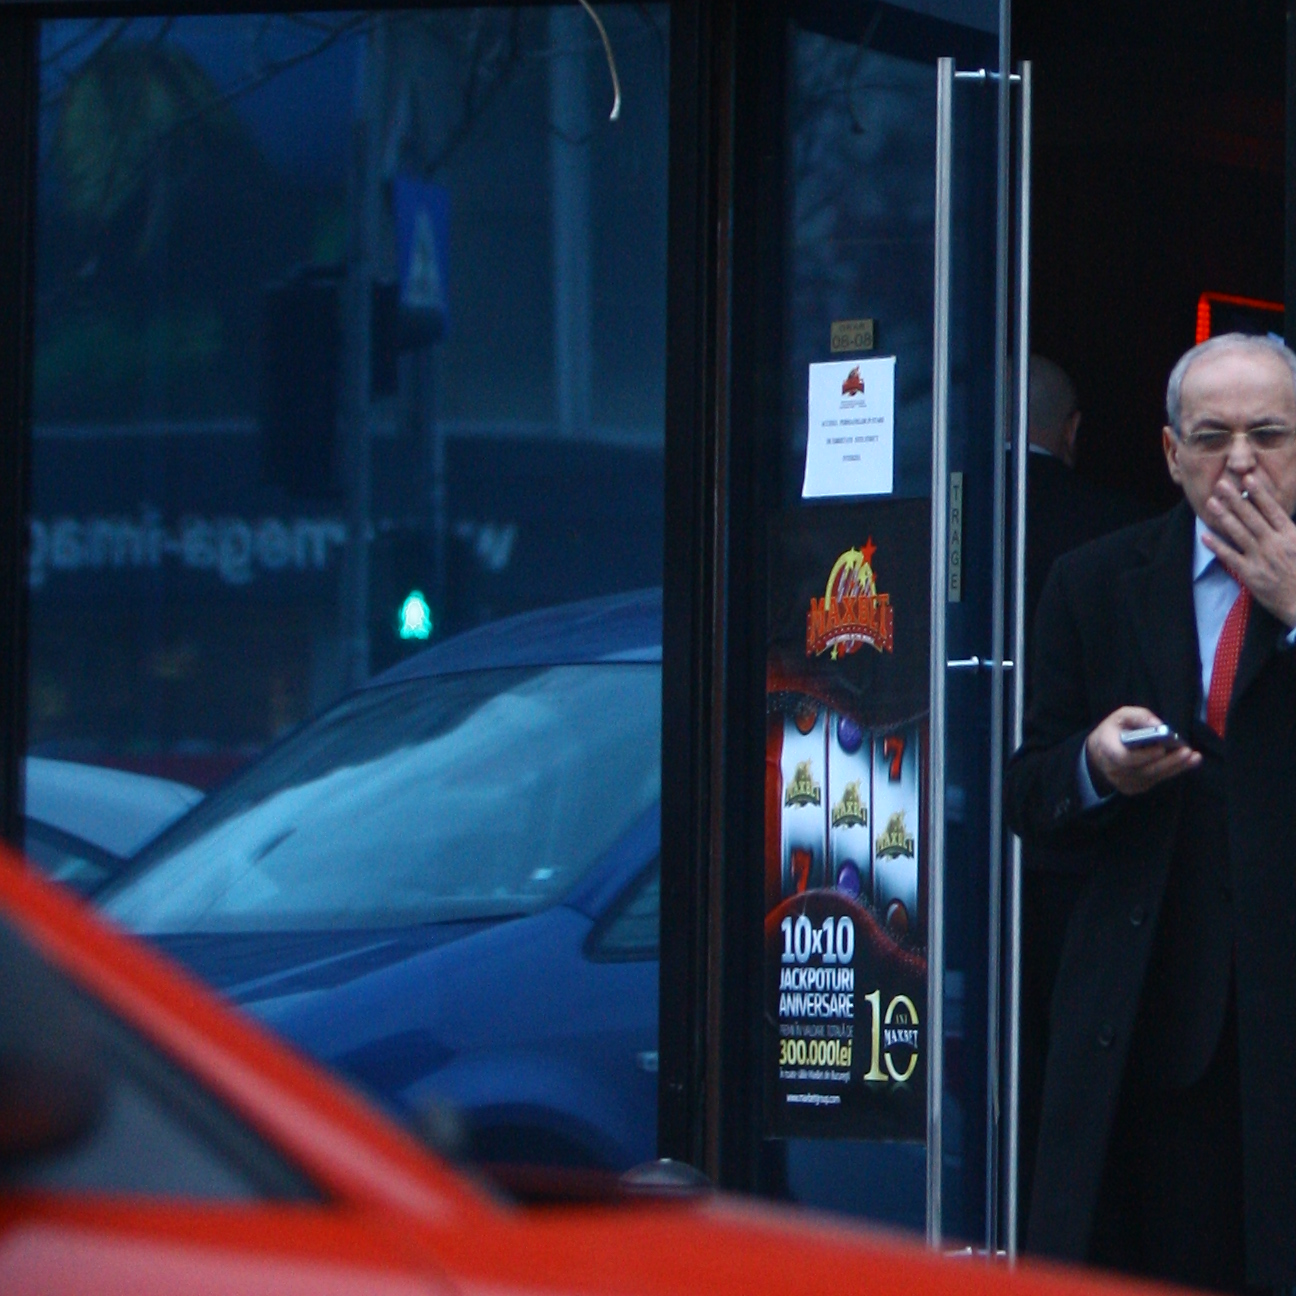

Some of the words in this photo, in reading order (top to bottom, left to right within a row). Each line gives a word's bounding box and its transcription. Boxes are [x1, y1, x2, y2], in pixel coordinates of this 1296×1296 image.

[832, 333, 872, 349] 08-08
[950, 485, 959, 589] TRAGE
[809, 593, 890, 646] MAXBET
[780, 915, 856, 965] 10x10
[779, 967, 855, 992] JACKPOTURI
[779, 993, 855, 1019] ANIVERSARE
[884, 1029, 918, 1049] MAXBET
